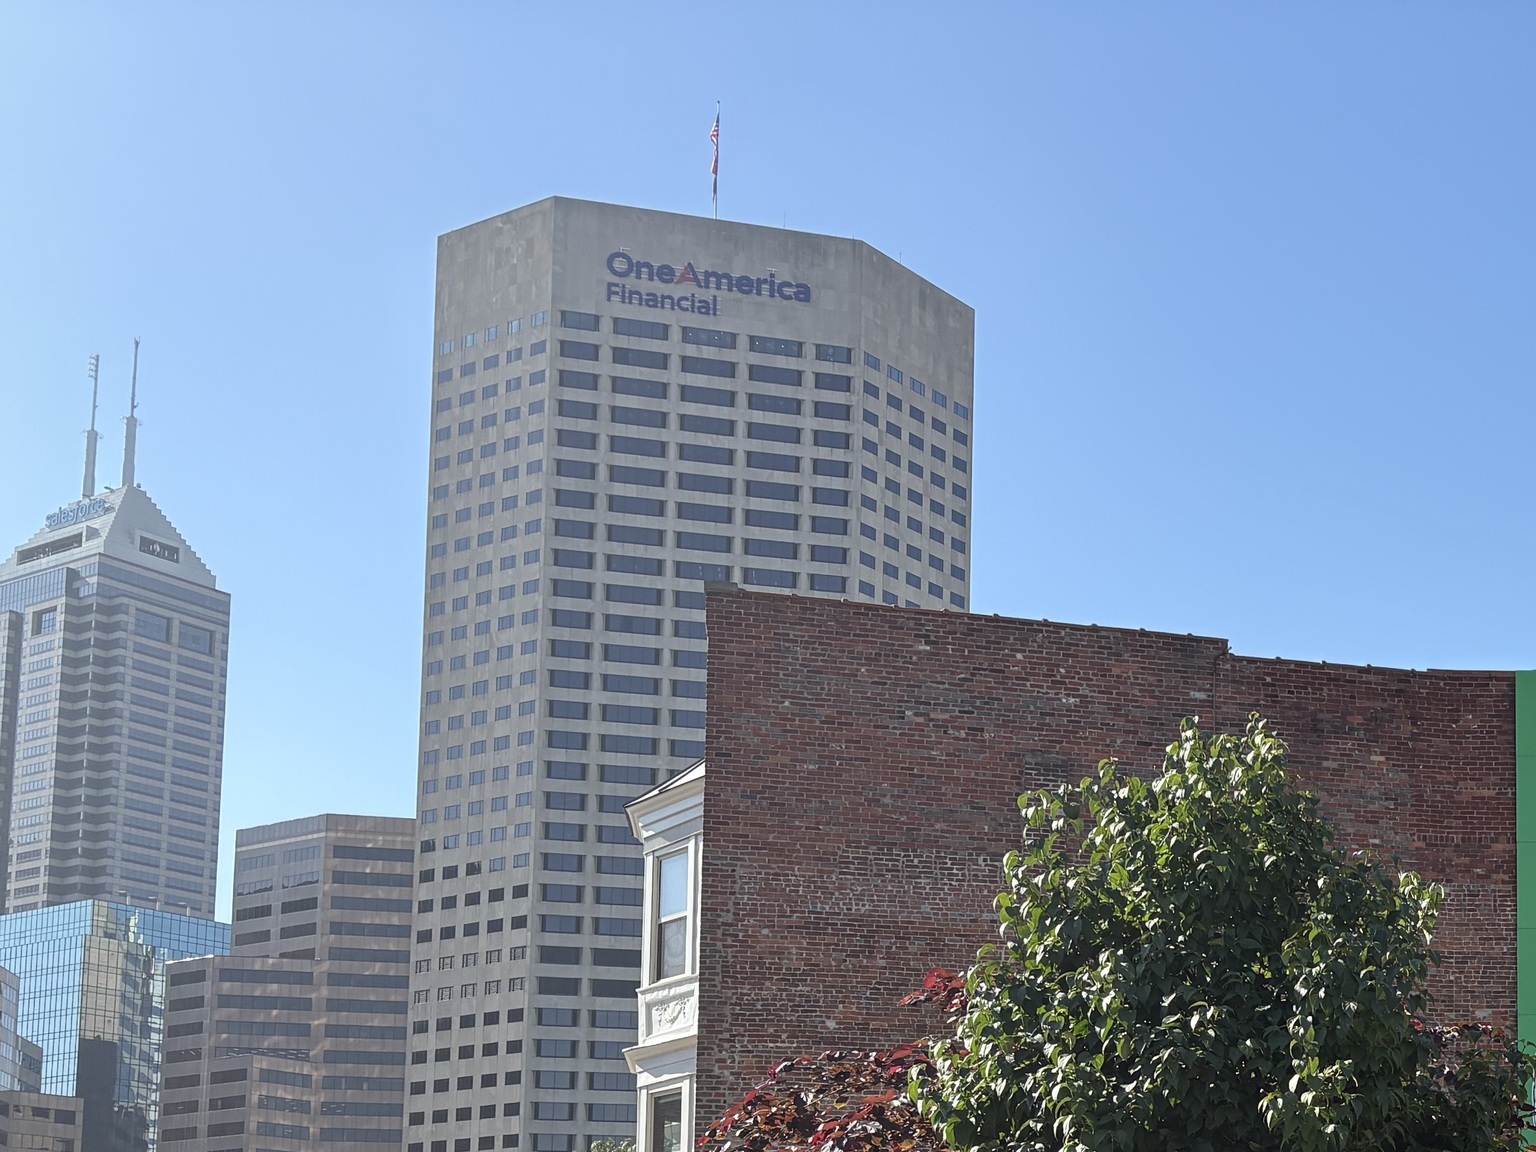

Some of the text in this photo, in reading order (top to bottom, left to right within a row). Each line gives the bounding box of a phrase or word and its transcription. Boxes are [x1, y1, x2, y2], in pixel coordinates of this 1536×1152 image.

[606, 251, 812, 304] OneAmerica
[606, 282, 718, 317] Financial
[45, 498, 105, 528] salesforce
